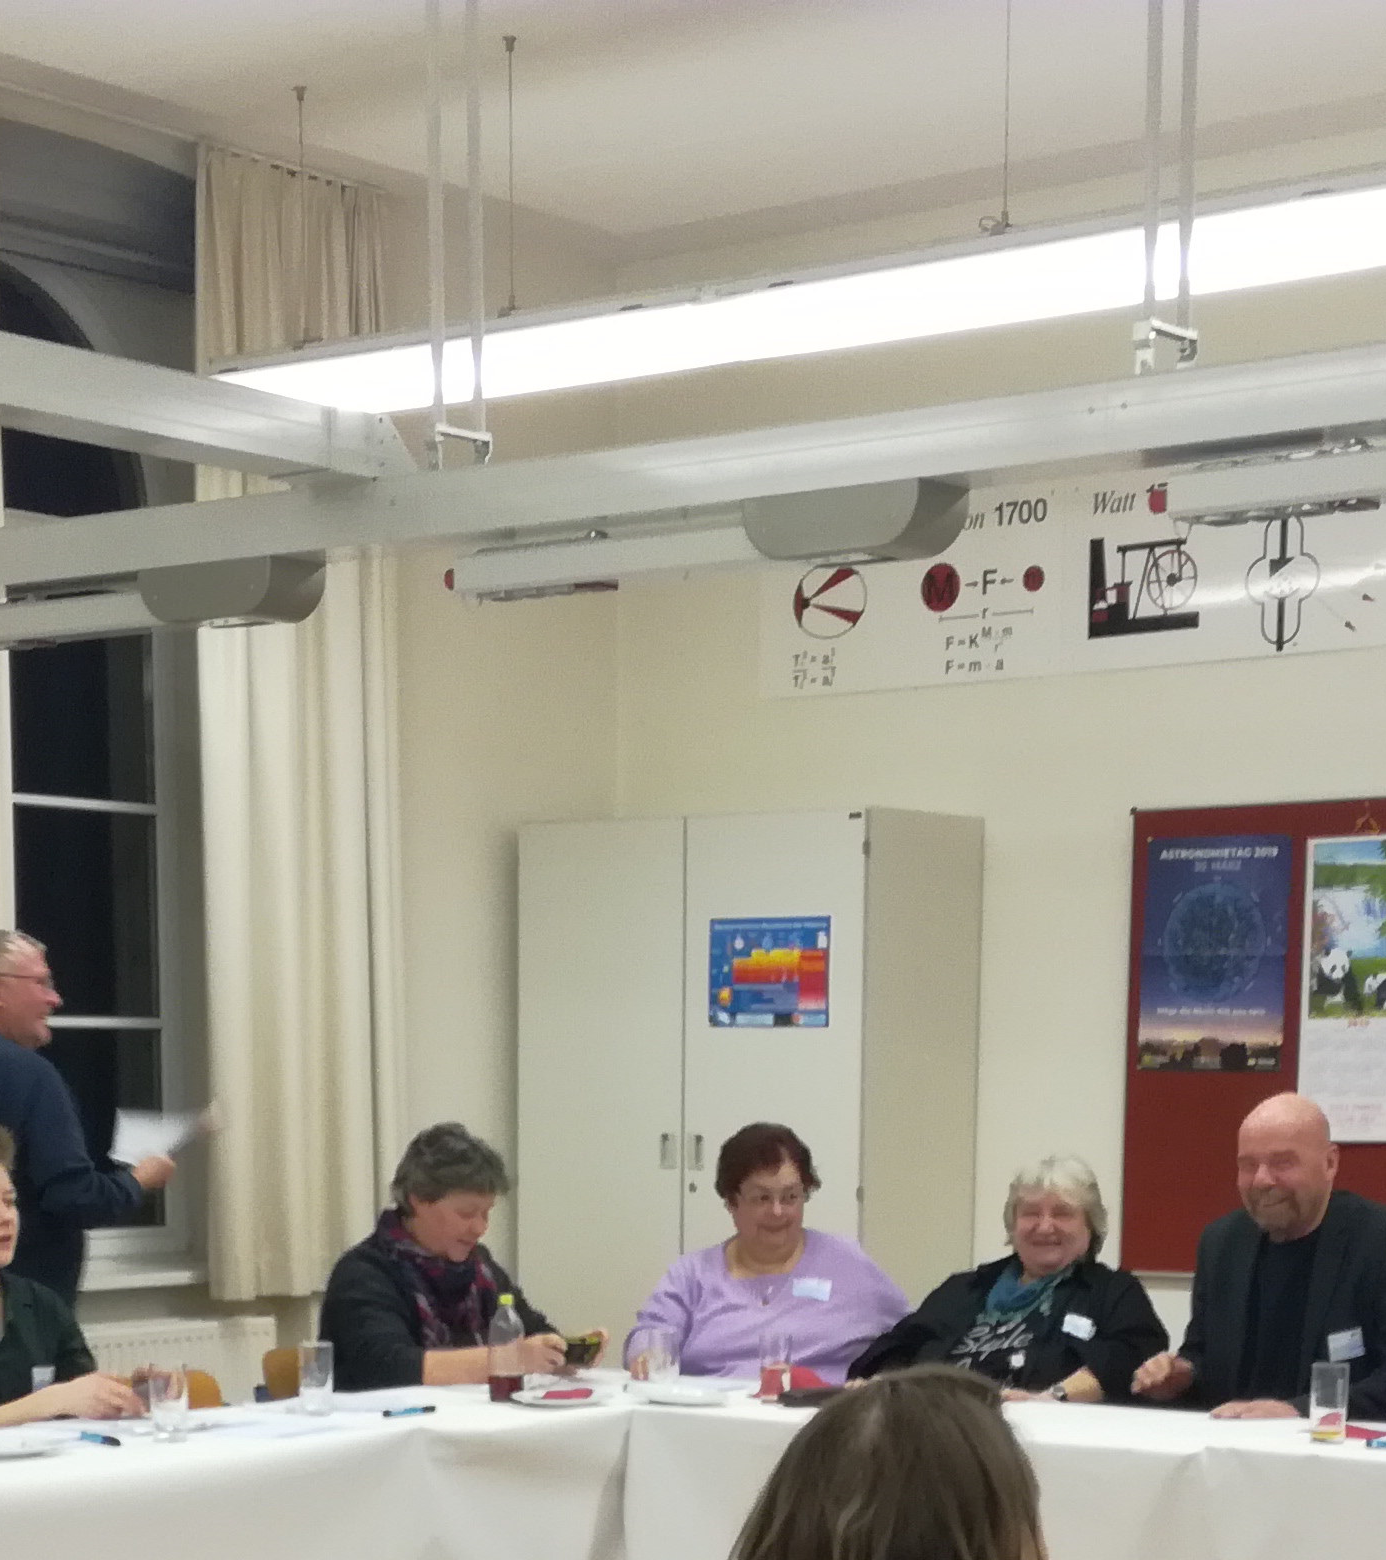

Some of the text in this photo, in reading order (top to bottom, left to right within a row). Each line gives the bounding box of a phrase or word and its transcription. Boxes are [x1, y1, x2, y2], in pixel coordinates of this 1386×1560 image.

[994, 498, 1048, 527] 1700
[1093, 490, 1137, 515] Watt
[982, 568, 998, 595] F
